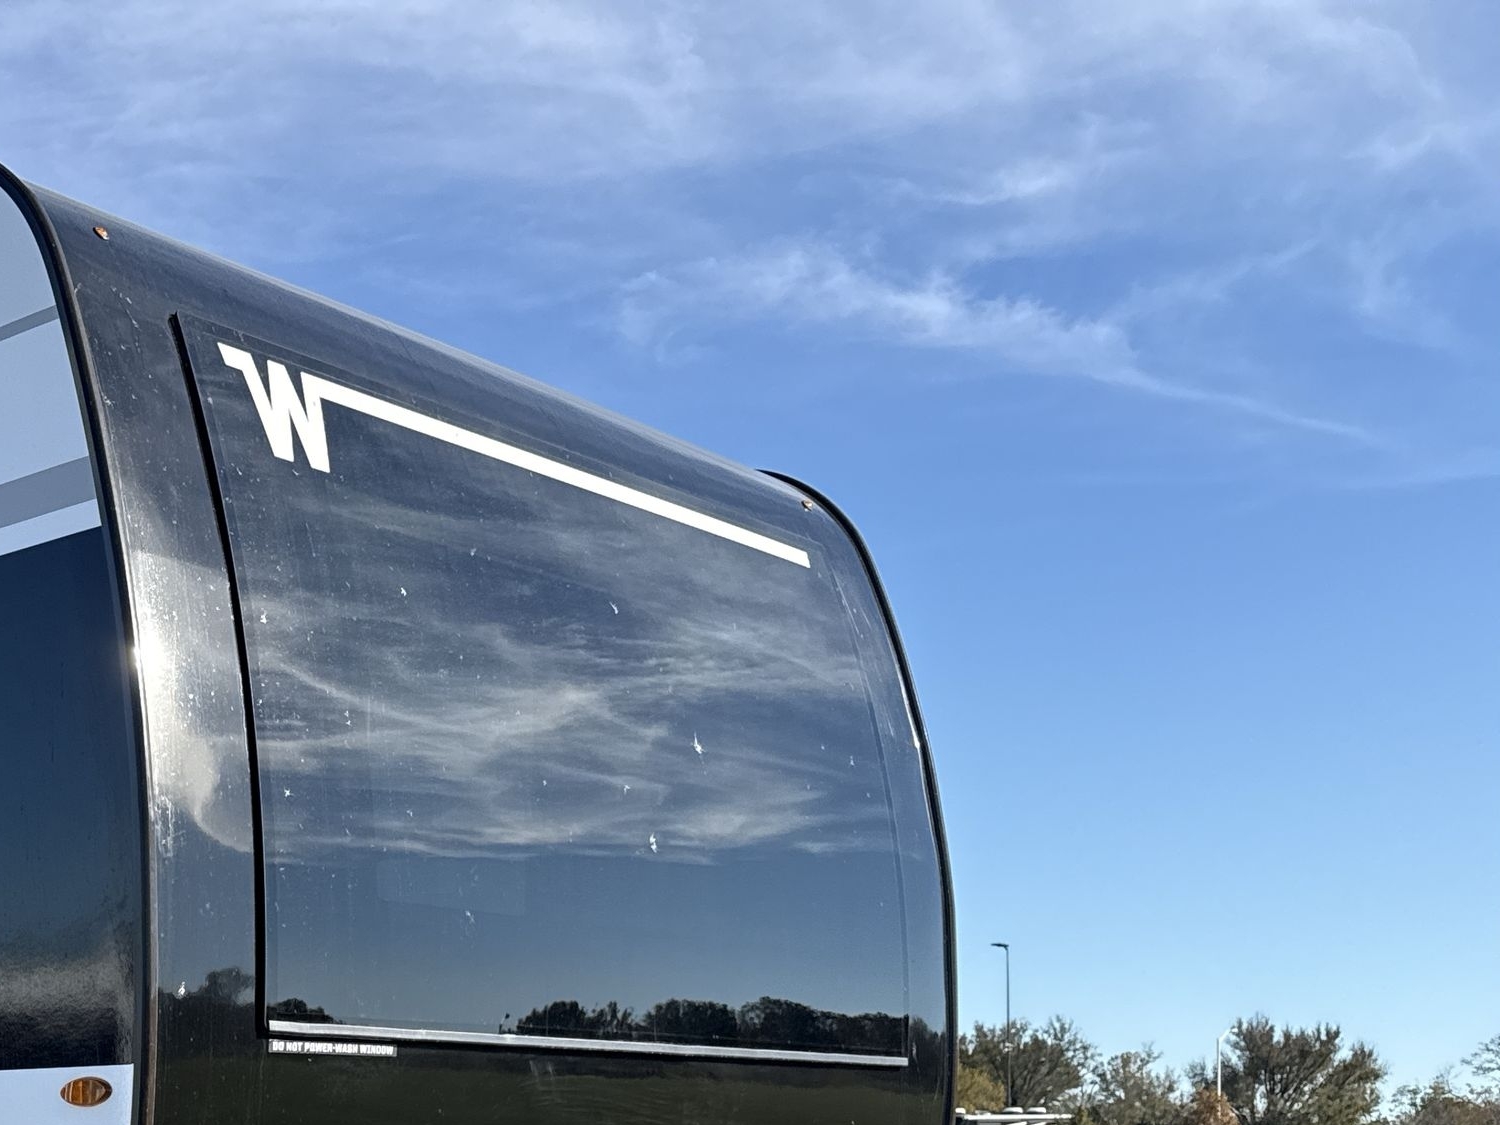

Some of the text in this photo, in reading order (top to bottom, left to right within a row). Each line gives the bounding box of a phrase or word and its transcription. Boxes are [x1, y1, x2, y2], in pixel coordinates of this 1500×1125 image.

[272, 1041, 394, 1055] DO NOT POWER-WASH WINDOW
